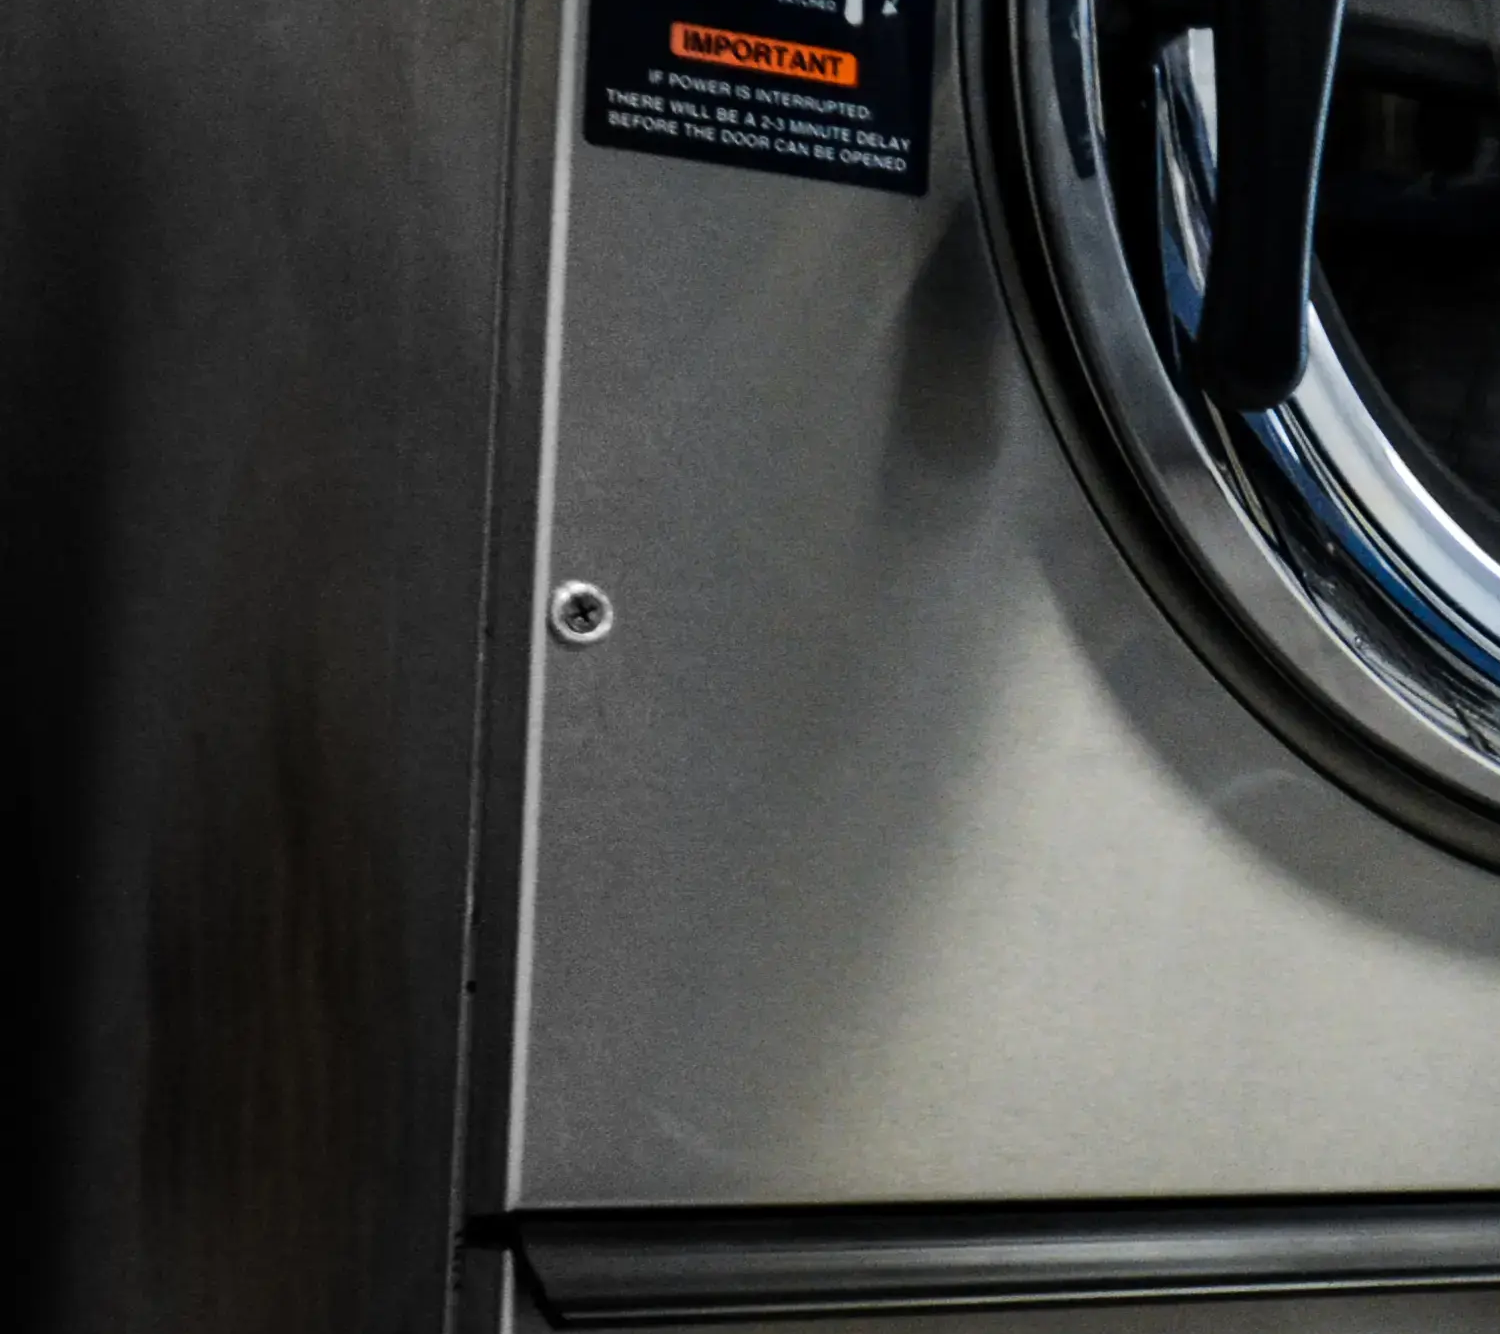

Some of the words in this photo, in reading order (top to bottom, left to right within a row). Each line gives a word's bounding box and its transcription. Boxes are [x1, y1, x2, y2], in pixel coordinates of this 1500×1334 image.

[683, 29, 843, 78] IMPORTANT
[649, 69, 664, 84] IF
[669, 73, 730, 96] POWER
[735, 86, 751, 101] IS
[606, 88, 664, 113] THERE
[670, 101, 709, 120] WILL
[716, 108, 739, 124] BE
[745, 112, 756, 127] A
[760, 115, 786, 133] 2-3
[789, 120, 851, 144] MINUTE
[856, 129, 911, 152] DELAY
[608, 111, 678, 136] BEFORE
[684, 123, 715, 142] THE
[721, 128, 771, 151] DOOR
[774, 138, 809, 157] CAN
[813, 144, 836, 161] BE
[839, 148, 907, 172] OPENED
